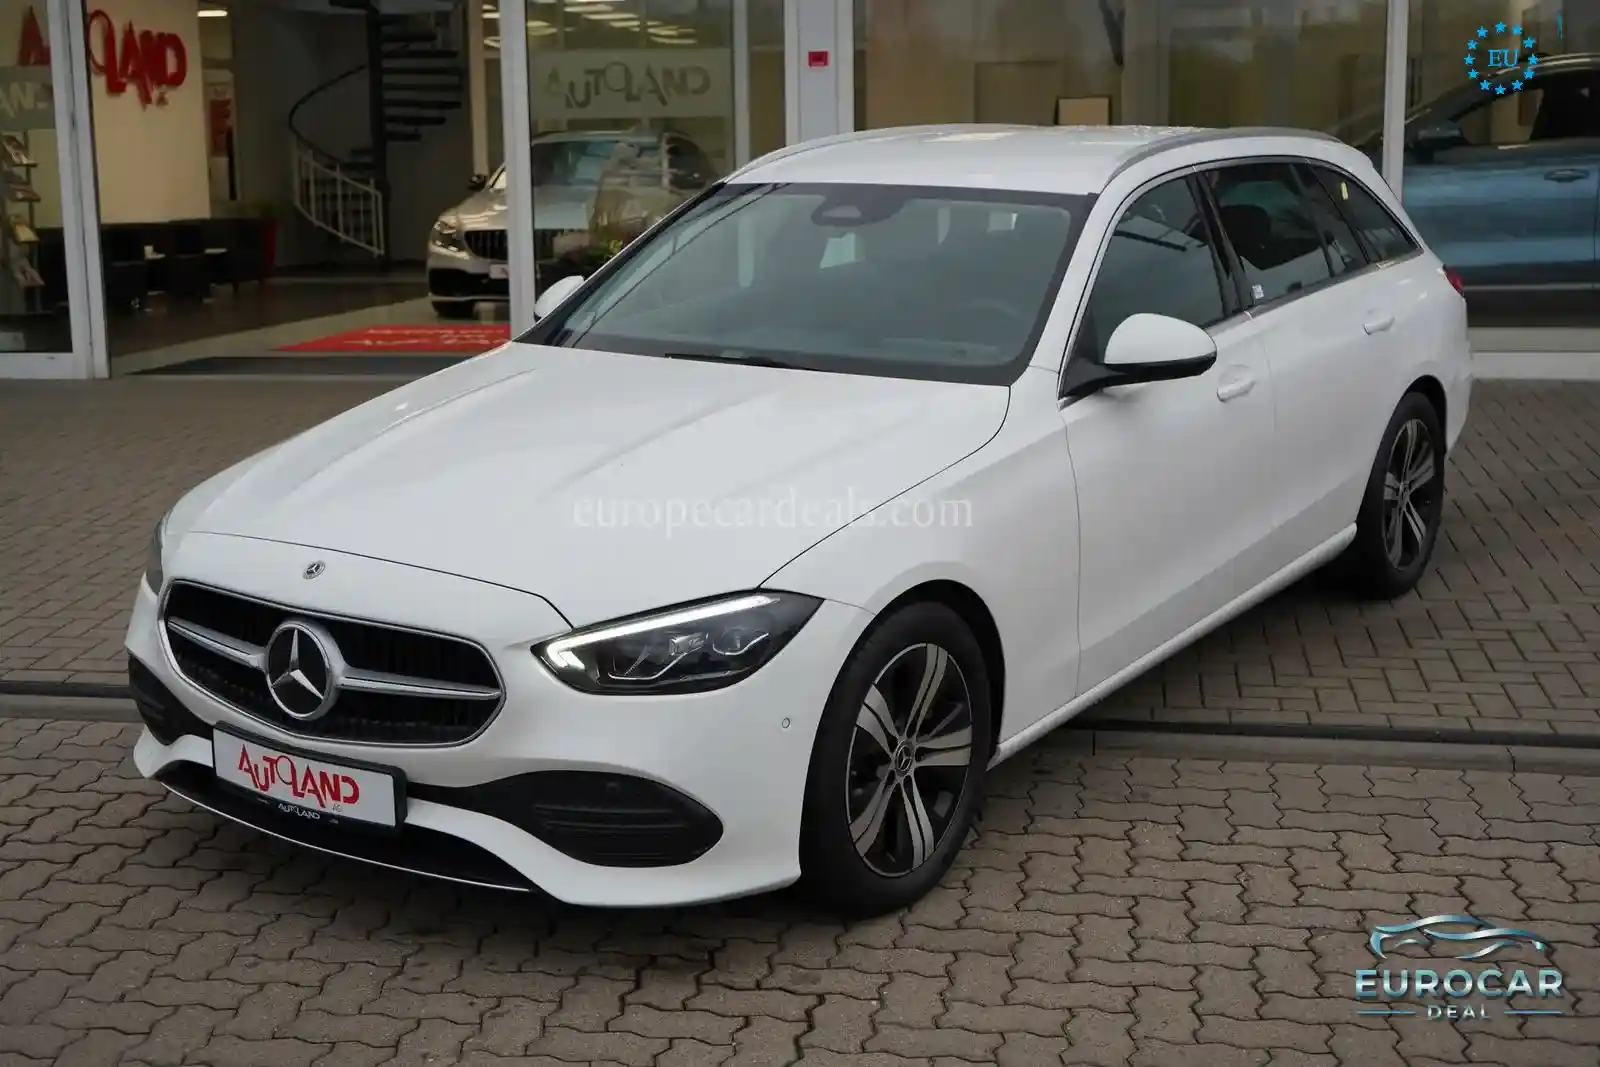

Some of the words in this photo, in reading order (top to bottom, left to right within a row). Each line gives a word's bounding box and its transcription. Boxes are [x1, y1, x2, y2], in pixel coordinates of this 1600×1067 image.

[546, 62, 711, 108] AUTOLAND
[239, 743, 360, 808] AUTOLAND
[278, 803, 321, 820] AUTOLAND
